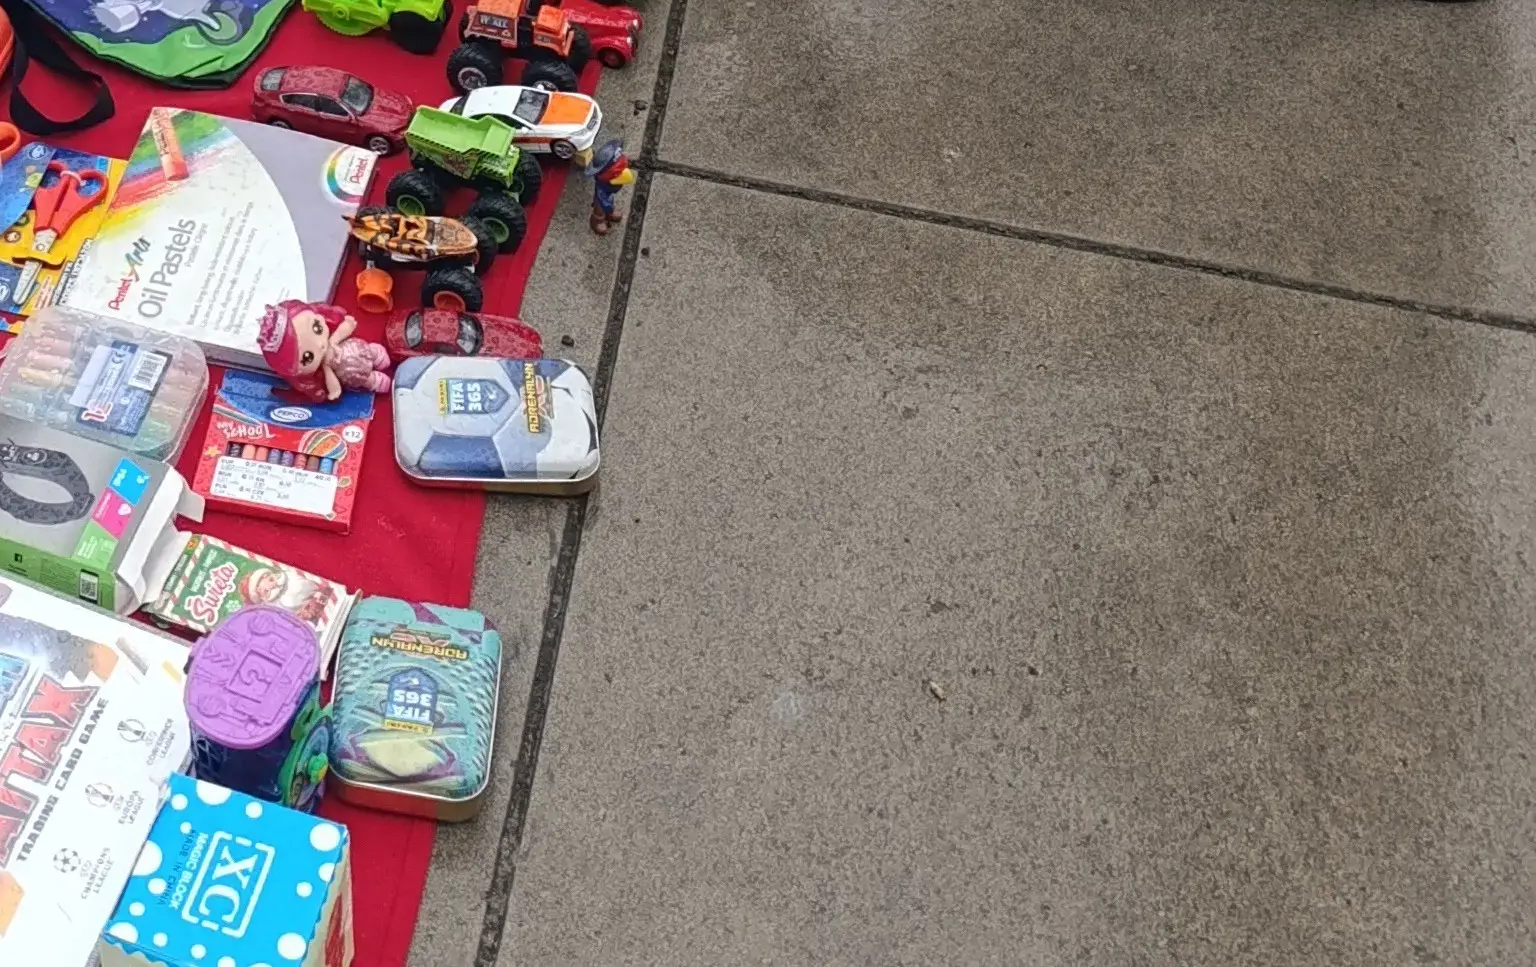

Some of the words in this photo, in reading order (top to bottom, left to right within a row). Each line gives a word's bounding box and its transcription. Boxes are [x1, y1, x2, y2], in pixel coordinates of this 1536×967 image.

[350, 157, 368, 185] Pentel
[138, 277, 170, 319] Oil
[156, 219, 196, 289] Pastels
[108, 276, 135, 311] Pentel
[450, 382, 464, 411] FIFA
[467, 382, 482, 412] 365
[524, 362, 541, 433] ADRENALYN
[276, 409, 306, 419] PEPCO
[344, 427, 361, 439] x12
[187, 562, 236, 624] Święta
[371, 636, 468, 661] ADRENALYN
[392, 705, 431, 722] FIFA
[393, 689, 433, 707] 365
[16, 794, 60, 862] TRADING
[54, 748, 84, 792] CARD
[78, 697, 110, 745] GAME
[126, 795, 146, 825] LEAGUE
[187, 832, 209, 869] MAGIC
[80, 846, 111, 900] CHAMPIONS
[92, 858, 115, 895] LEAGUE
[198, 844, 259, 924] XC
[156, 875, 178, 907] CHINA
[168, 869, 195, 911] BLOCK
